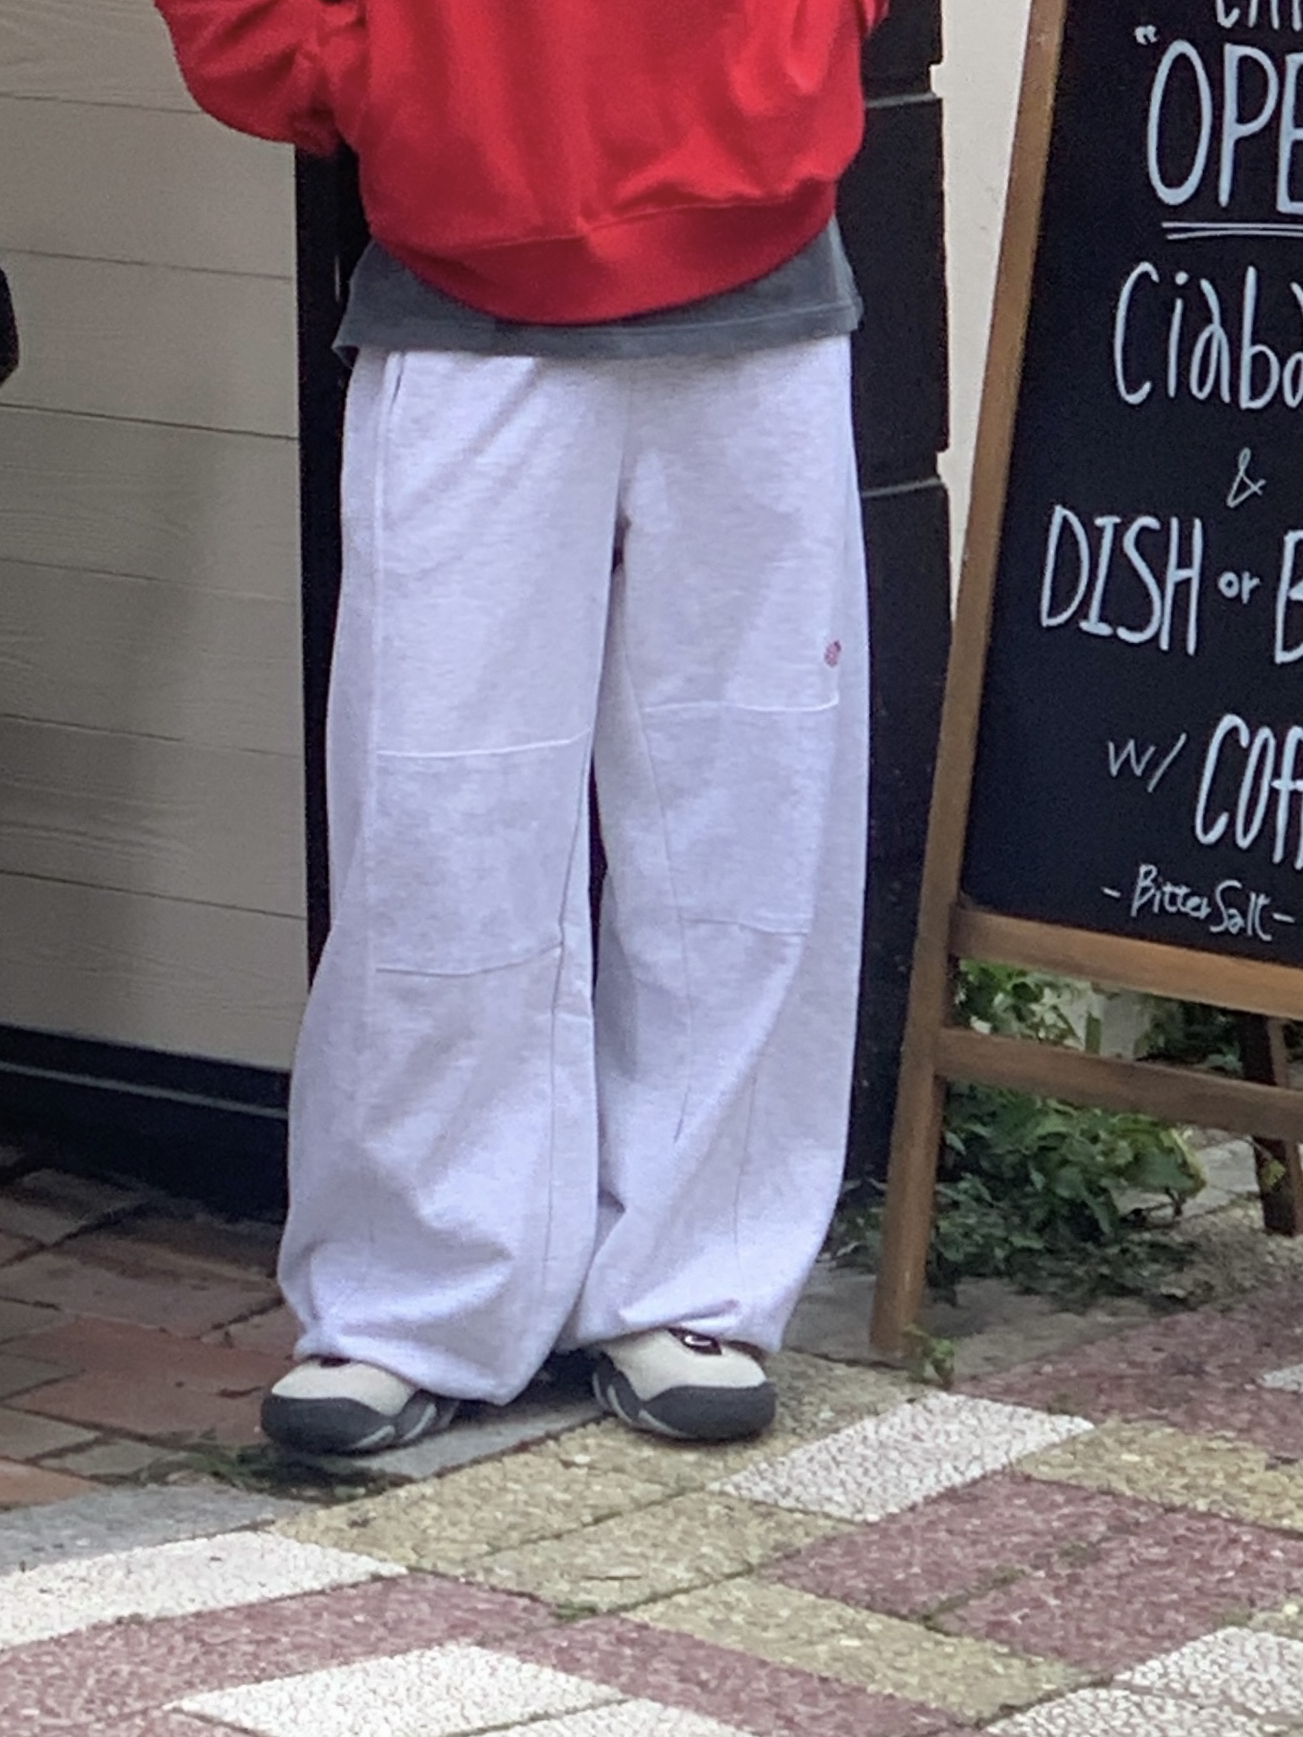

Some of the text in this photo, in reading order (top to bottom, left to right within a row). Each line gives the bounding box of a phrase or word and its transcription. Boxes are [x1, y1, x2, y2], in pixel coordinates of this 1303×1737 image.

[1227, 446, 1267, 509] &
[1040, 504, 1203, 657] DISH
[1217, 570, 1261, 605] or
